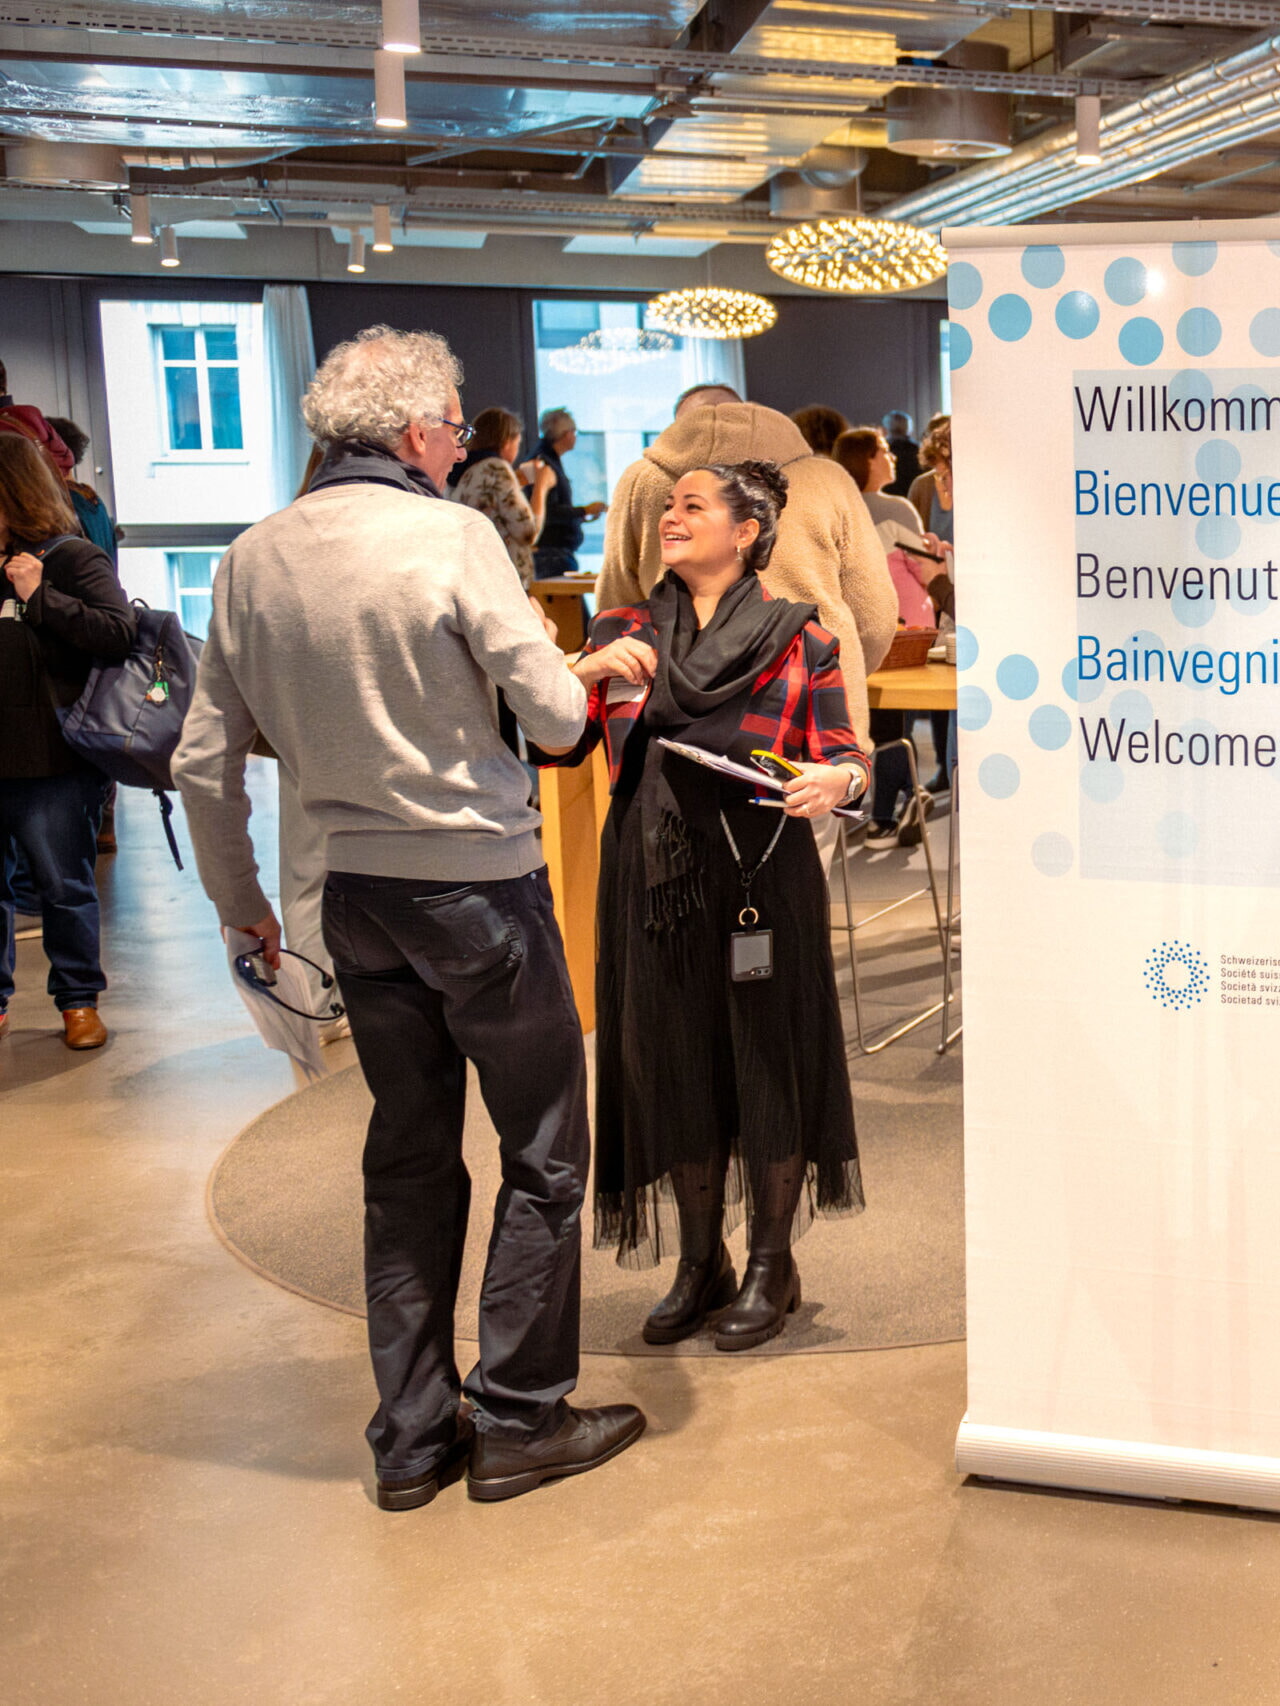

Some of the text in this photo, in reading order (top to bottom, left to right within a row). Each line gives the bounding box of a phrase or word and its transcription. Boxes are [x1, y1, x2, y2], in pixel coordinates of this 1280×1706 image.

[1077, 635, 1280, 695] Bainvegni
[1079, 717, 1277, 767] Welcome
[1220, 968, 1257, 978] Société
[1220, 980, 1257, 992] Società
[1220, 994, 1262, 1005] Societad
